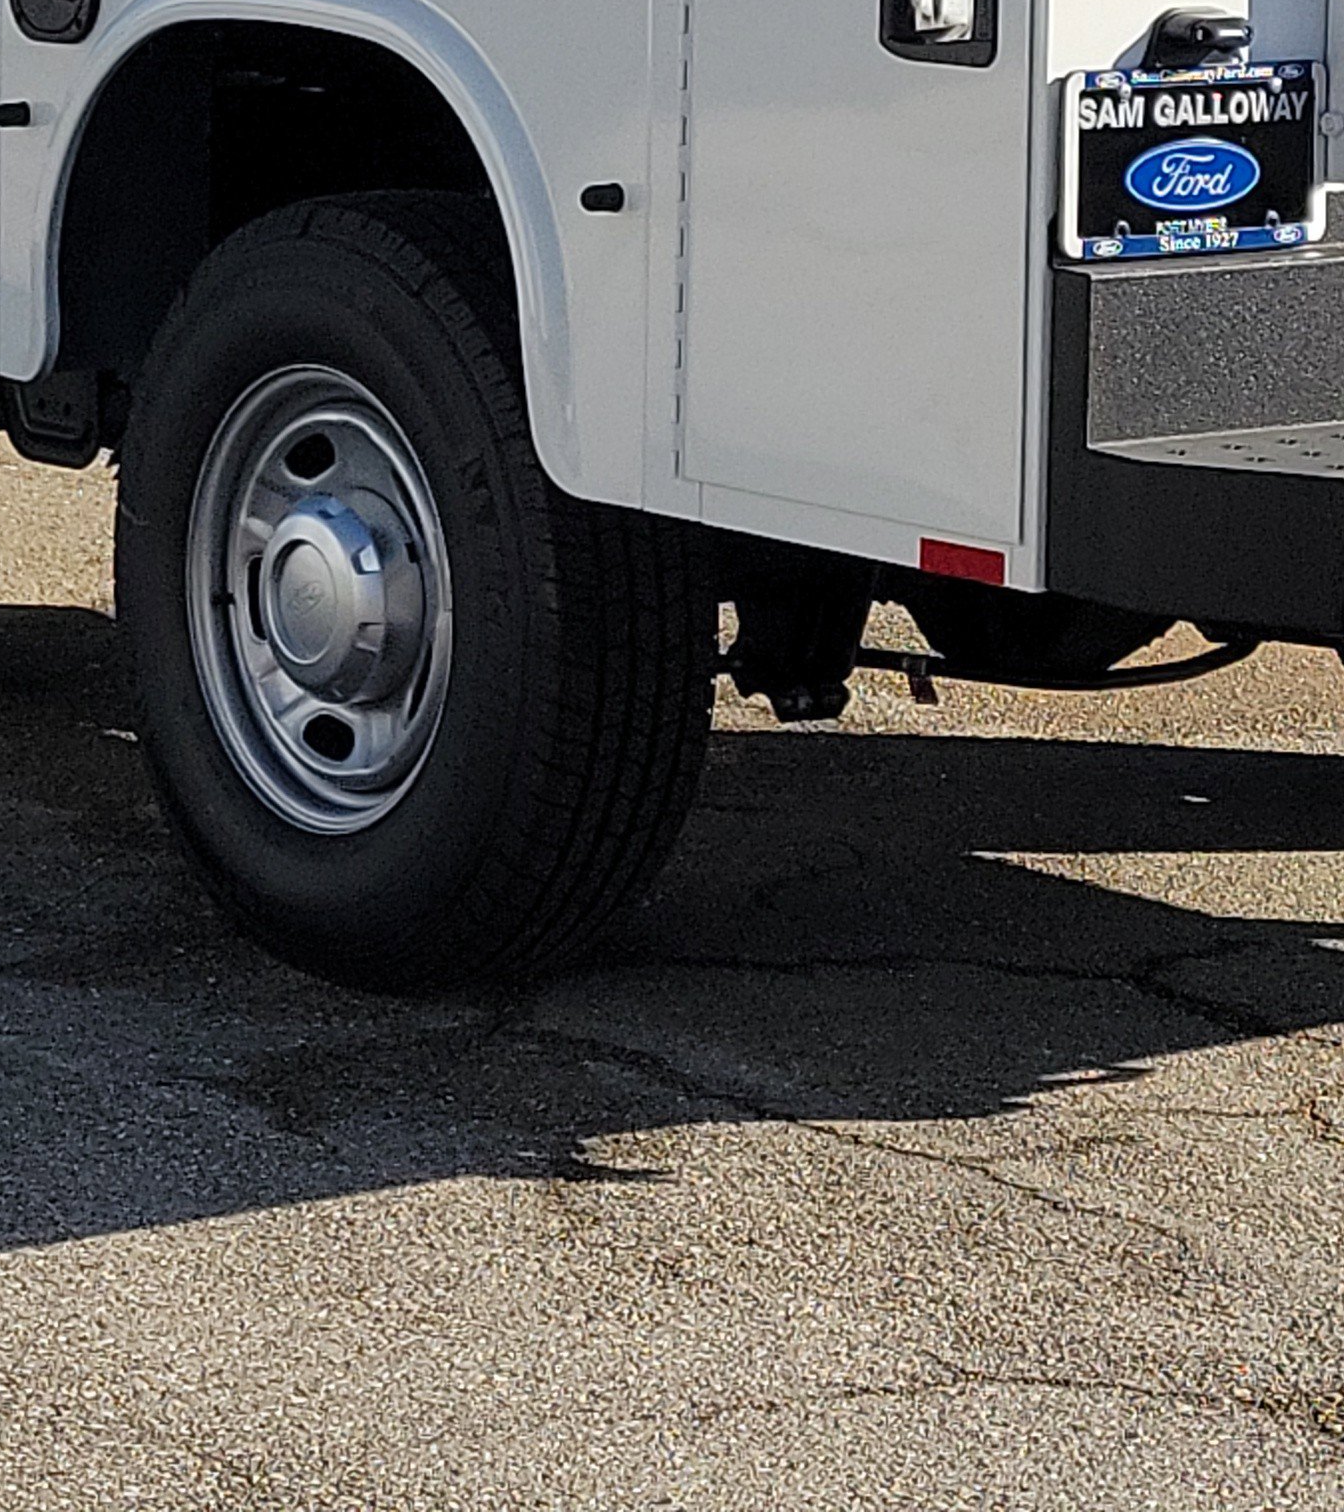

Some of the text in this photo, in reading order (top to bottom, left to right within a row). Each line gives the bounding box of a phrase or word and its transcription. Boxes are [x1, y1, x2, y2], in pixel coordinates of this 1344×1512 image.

[1079, 89, 1309, 130] SAM GALLOWAY
[1152, 152, 1233, 197] Ford
[1159, 232, 1239, 252] Since 1927
